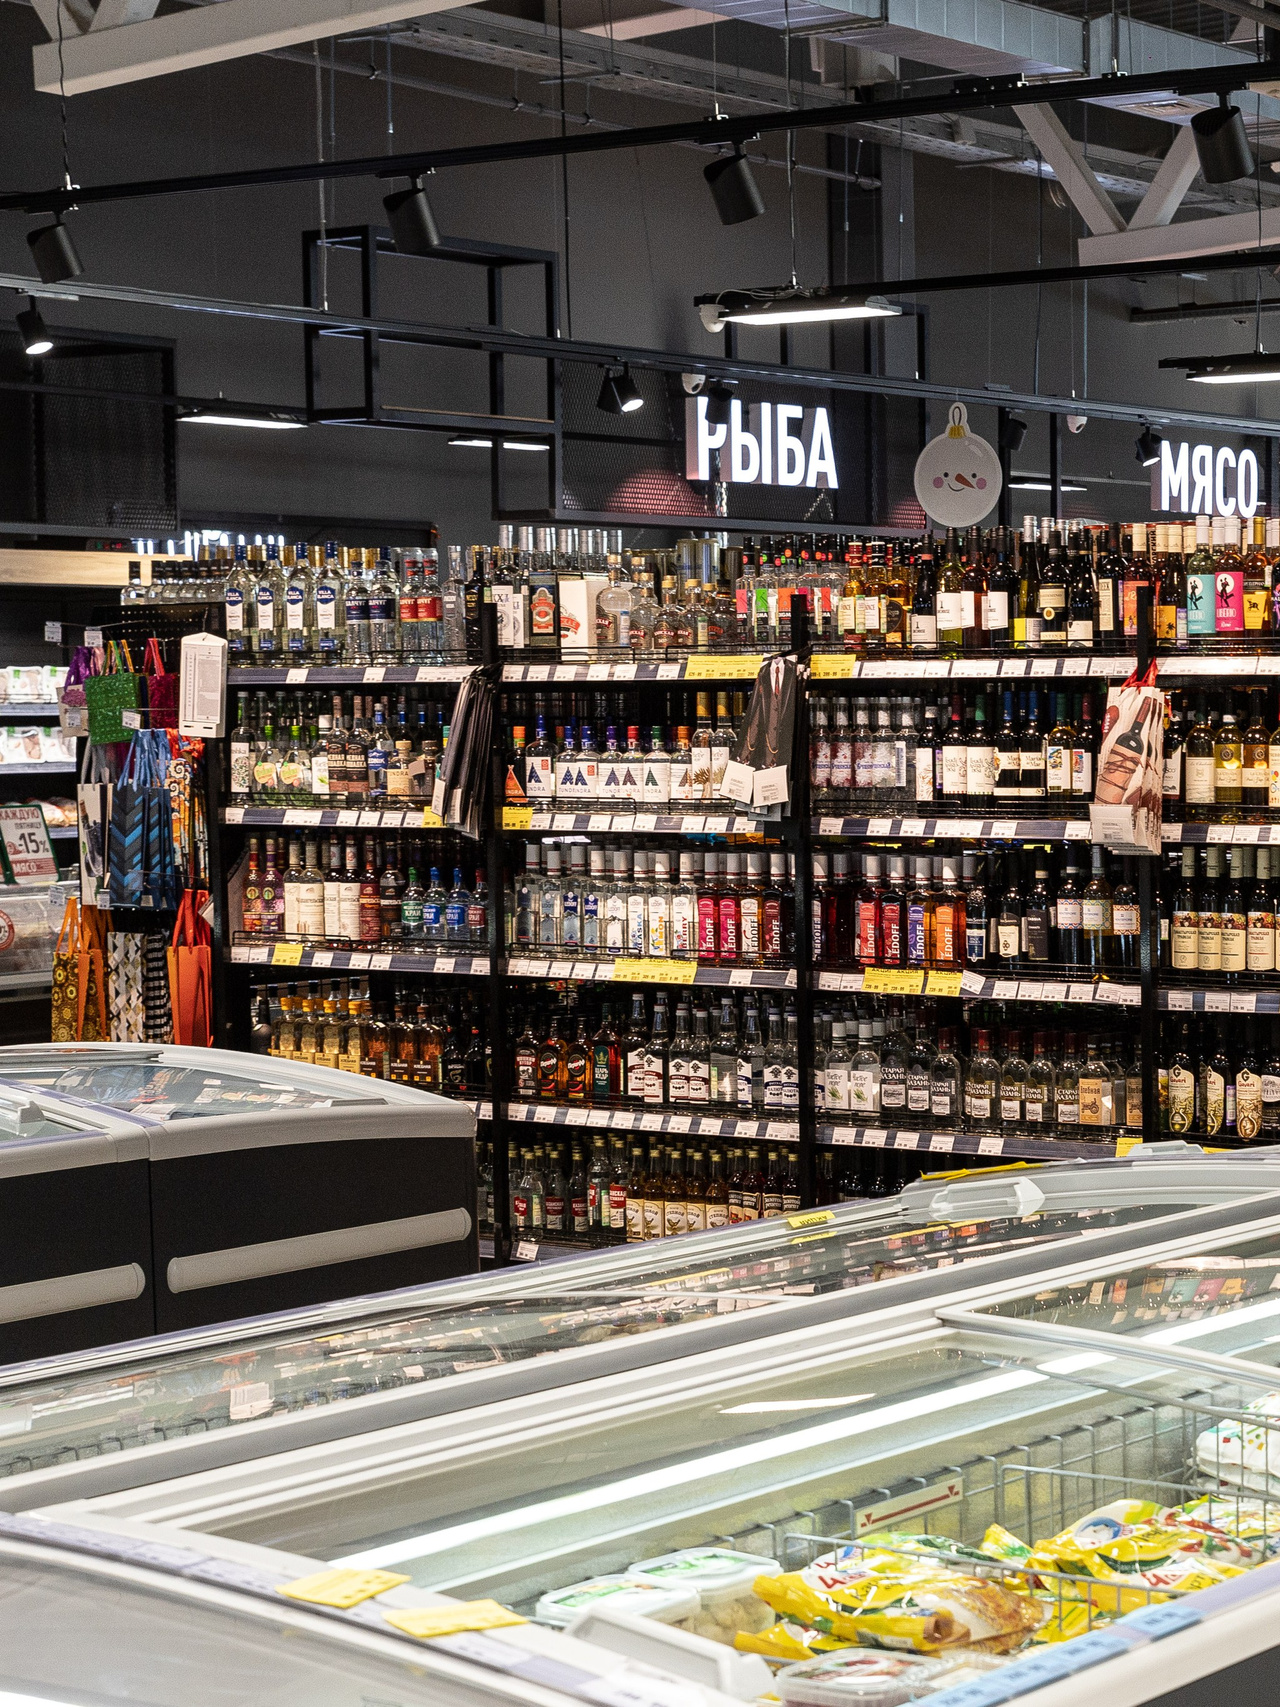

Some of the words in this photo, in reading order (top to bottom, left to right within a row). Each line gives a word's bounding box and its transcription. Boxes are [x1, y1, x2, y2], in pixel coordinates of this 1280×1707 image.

[697, 396, 839, 489] РЫБА
[1160, 440, 1259, 518] МЯСО
[13, 862, 37, 873] МЯСО
[727, 917, 736, 950] LEDOFF
